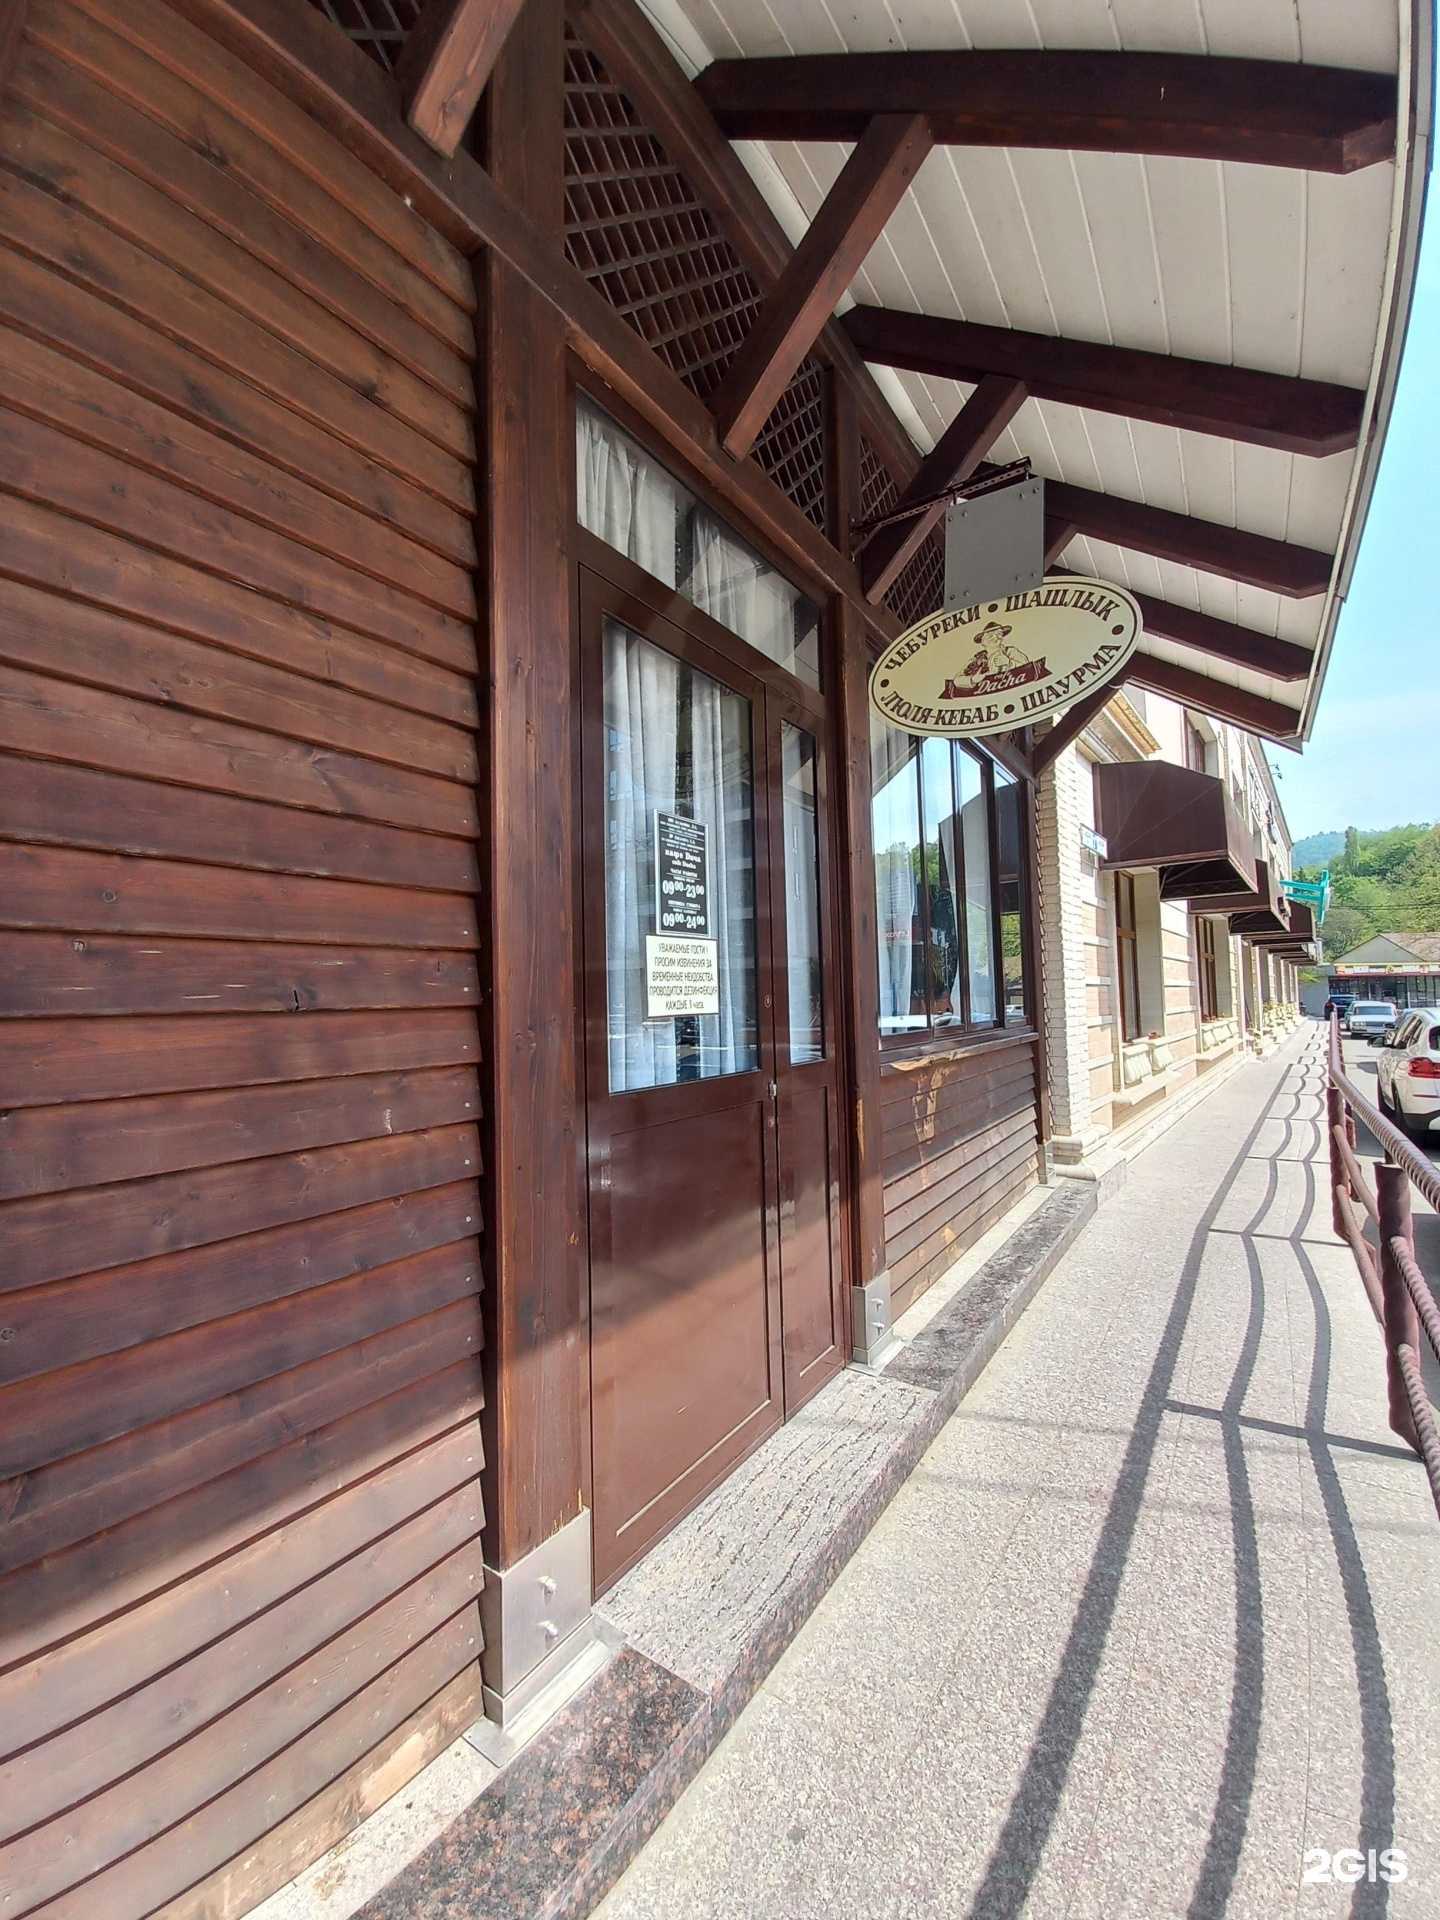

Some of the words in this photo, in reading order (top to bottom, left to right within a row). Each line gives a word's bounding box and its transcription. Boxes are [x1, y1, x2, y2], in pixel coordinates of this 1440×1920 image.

[1005, 589, 1120, 621] ШАШЛЫК
[885, 605, 981, 671] ЧЕБУРЕКИ
[973, 673, 1026, 695] Dacha
[1019, 642, 1122, 712] ШАУРМА
[880, 690, 999, 726] ЛЮЛЯ-КЕБАБ
